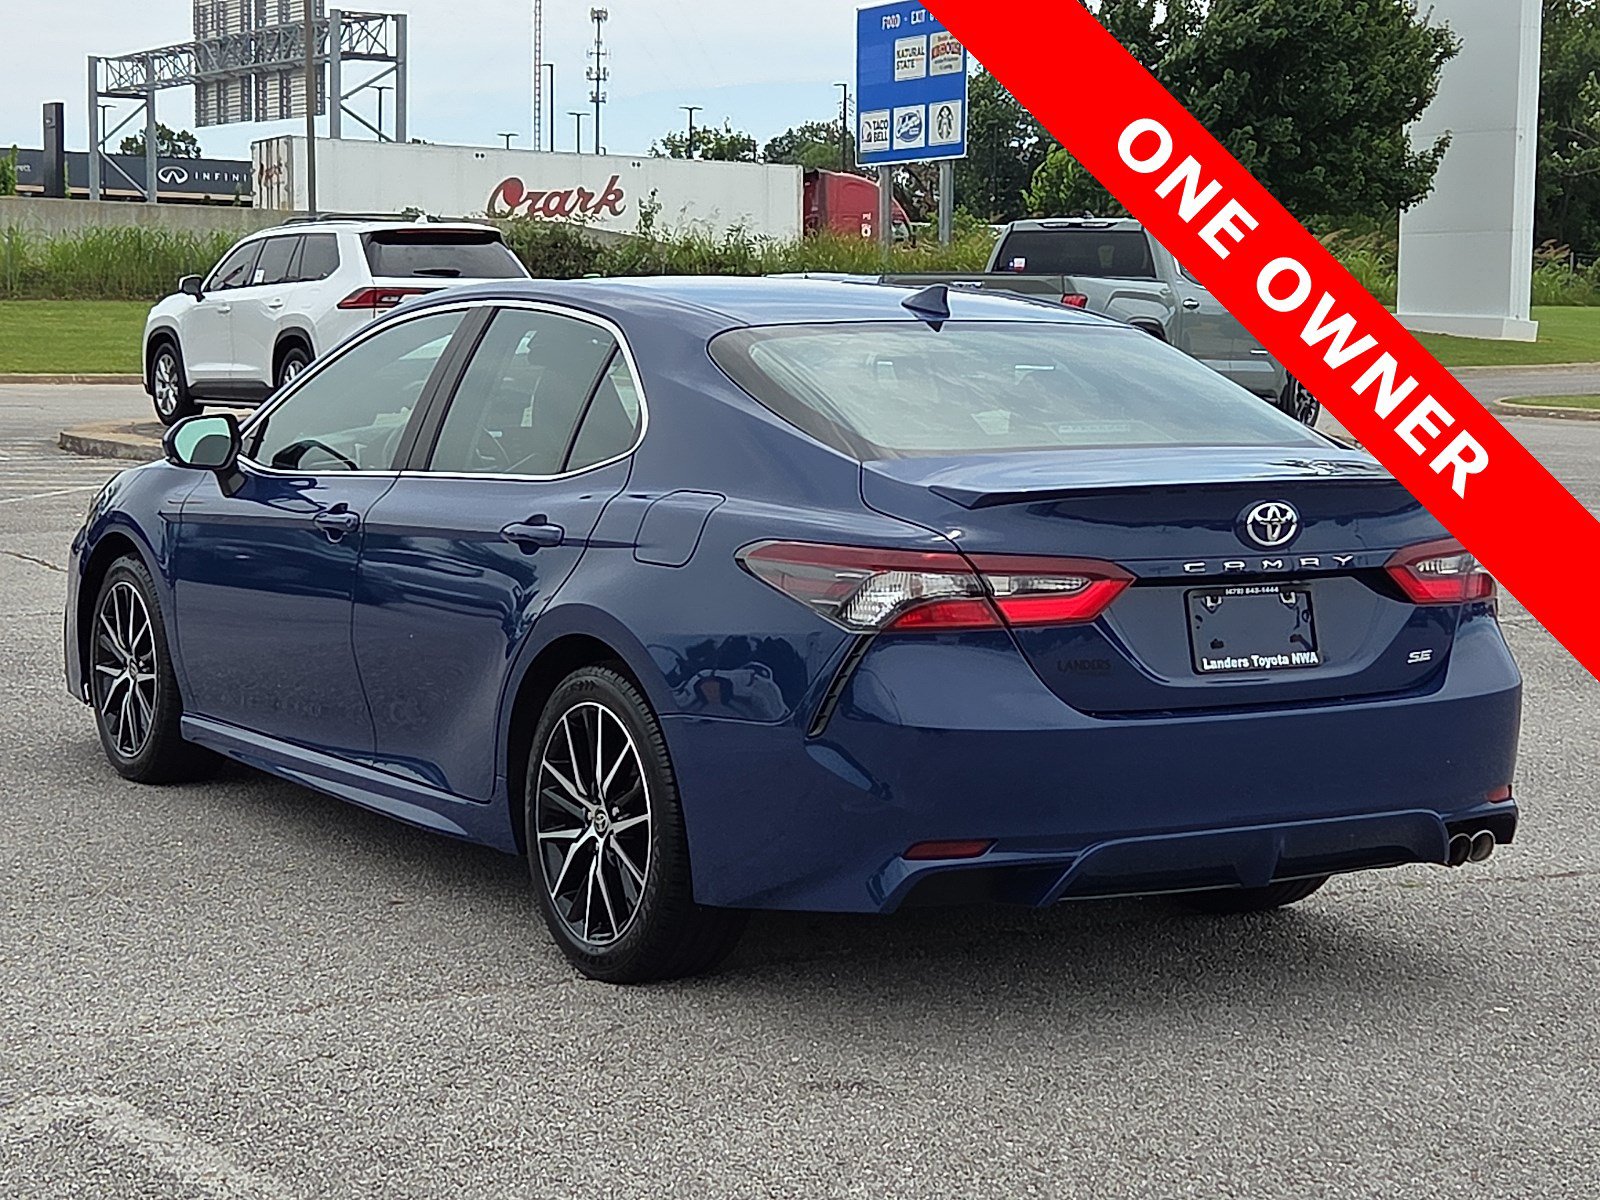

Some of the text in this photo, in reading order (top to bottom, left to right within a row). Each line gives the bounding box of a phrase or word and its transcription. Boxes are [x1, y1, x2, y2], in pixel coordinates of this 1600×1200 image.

[881, 13, 901, 31] FOOD
[910, 9, 926, 25] EXIT
[896, 46, 925, 59] NATURAL
[896, 59, 915, 70] STATE
[872, 119, 888, 131] TACO
[873, 130, 888, 143] BELL
[487, 174, 627, 219] Ozark
[1183, 555, 1354, 573] CAMRY
[1202, 651, 1319, 671] Landers Toyota NWA
[1407, 649, 1433, 664] SE
